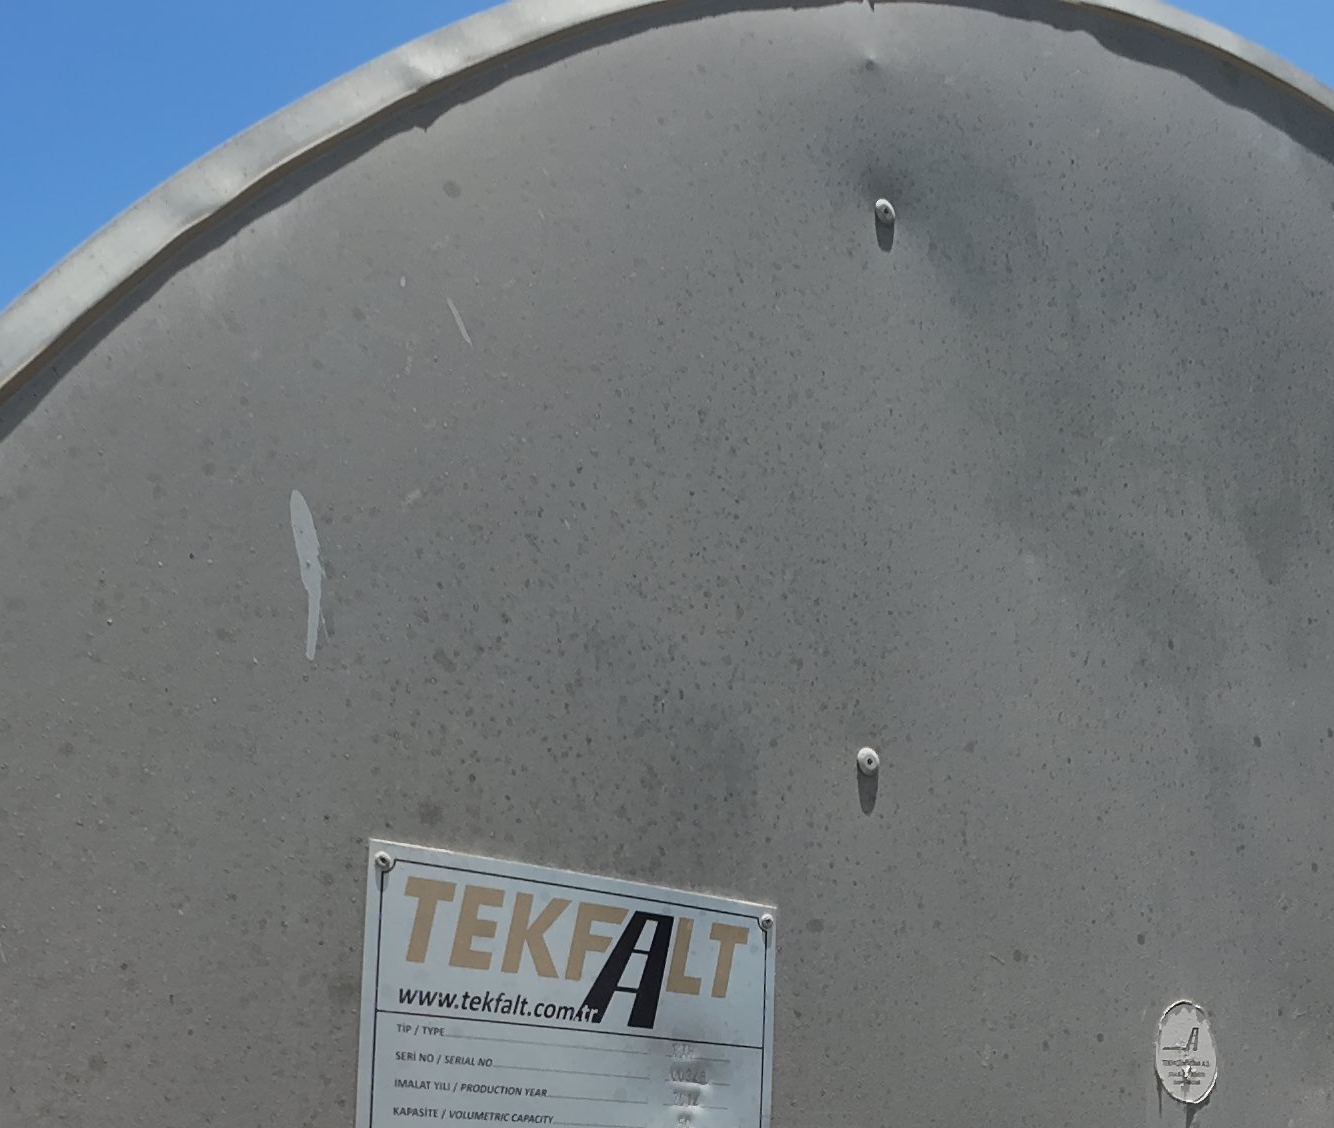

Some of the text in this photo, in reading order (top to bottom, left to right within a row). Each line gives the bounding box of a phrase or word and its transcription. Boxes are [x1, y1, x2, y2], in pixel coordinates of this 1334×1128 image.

[404, 876, 749, 1028] TEKFALT
[398, 987, 599, 1024] www.tekfalt.com.tr
[422, 1026, 445, 1037] TYPE
[419, 1053, 434, 1063] NO
[444, 1055, 475, 1066] SERIAL
[477, 1058, 493, 1068] NO
[460, 1083, 522, 1096] PRODUCTION
[524, 1087, 547, 1098] YEAR
[449, 1110, 510, 1122] VOLUMETRIC
[511, 1113, 554, 1125] CAPACITY
